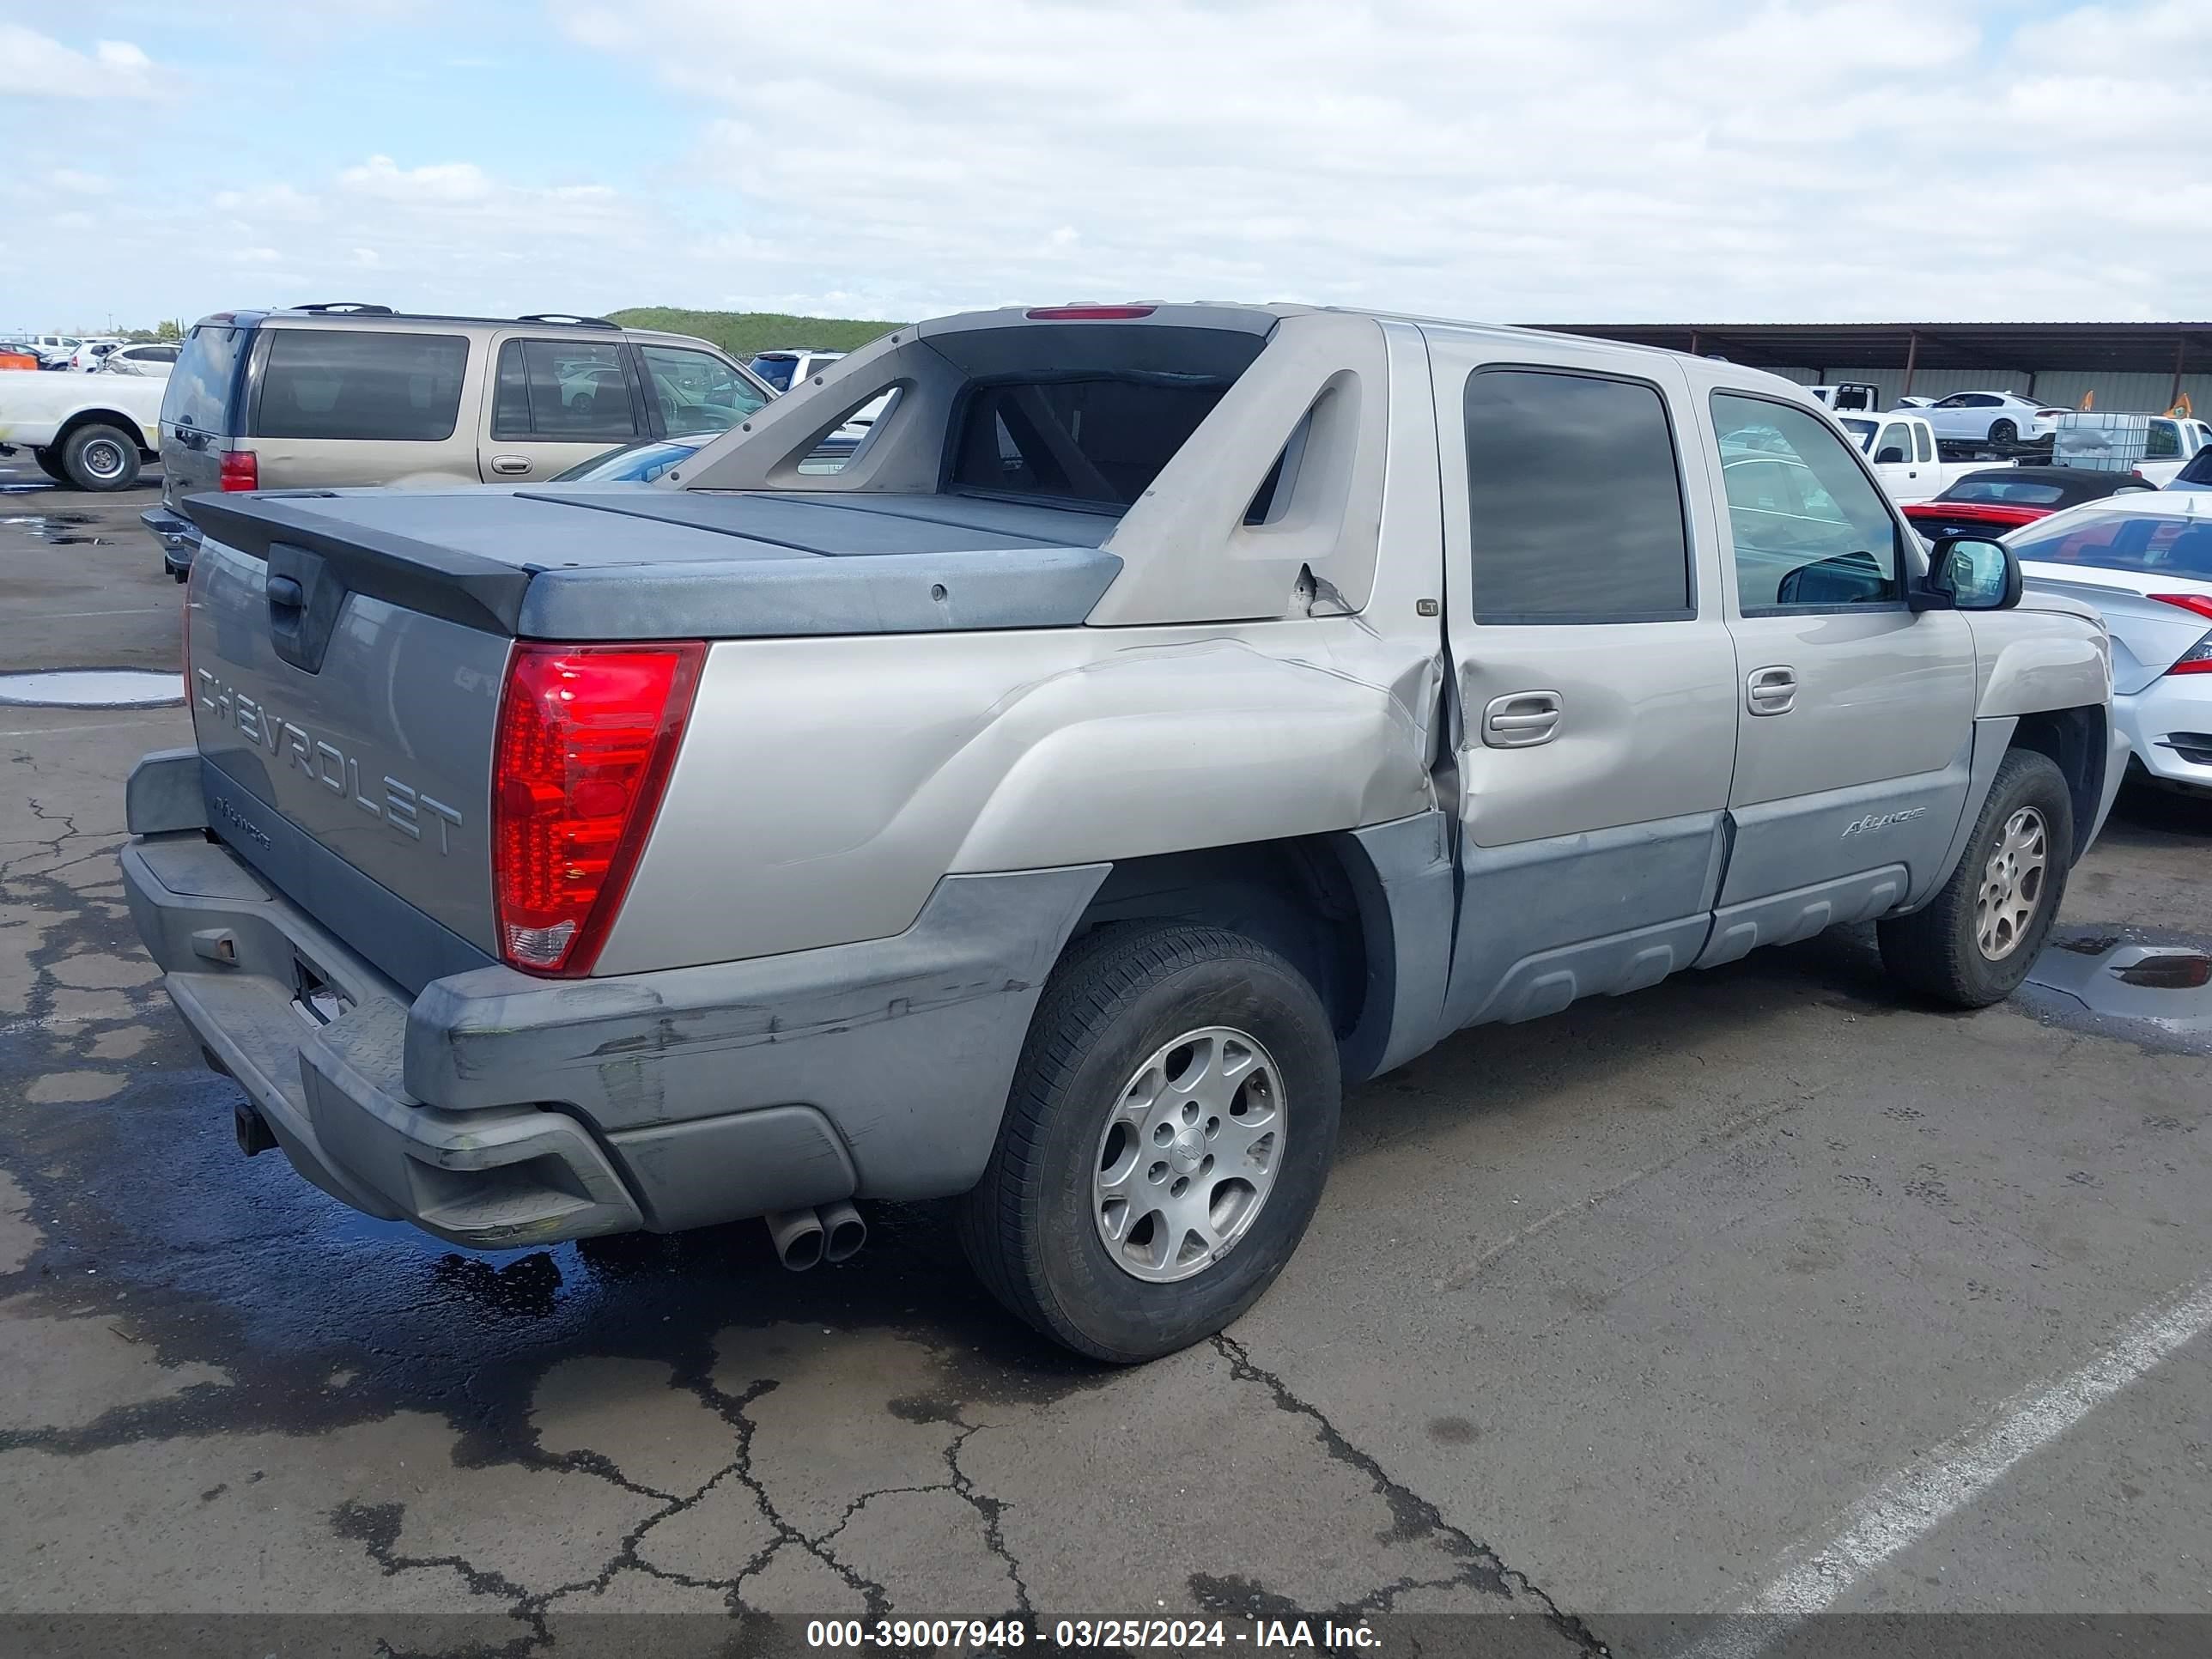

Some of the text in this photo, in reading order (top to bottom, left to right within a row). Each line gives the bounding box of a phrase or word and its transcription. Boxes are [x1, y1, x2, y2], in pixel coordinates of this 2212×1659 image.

[1418, 601, 1437, 613] LT
[198, 667, 463, 857] CHEVROLET
[1841, 806, 1927, 840] AVALANCHE
